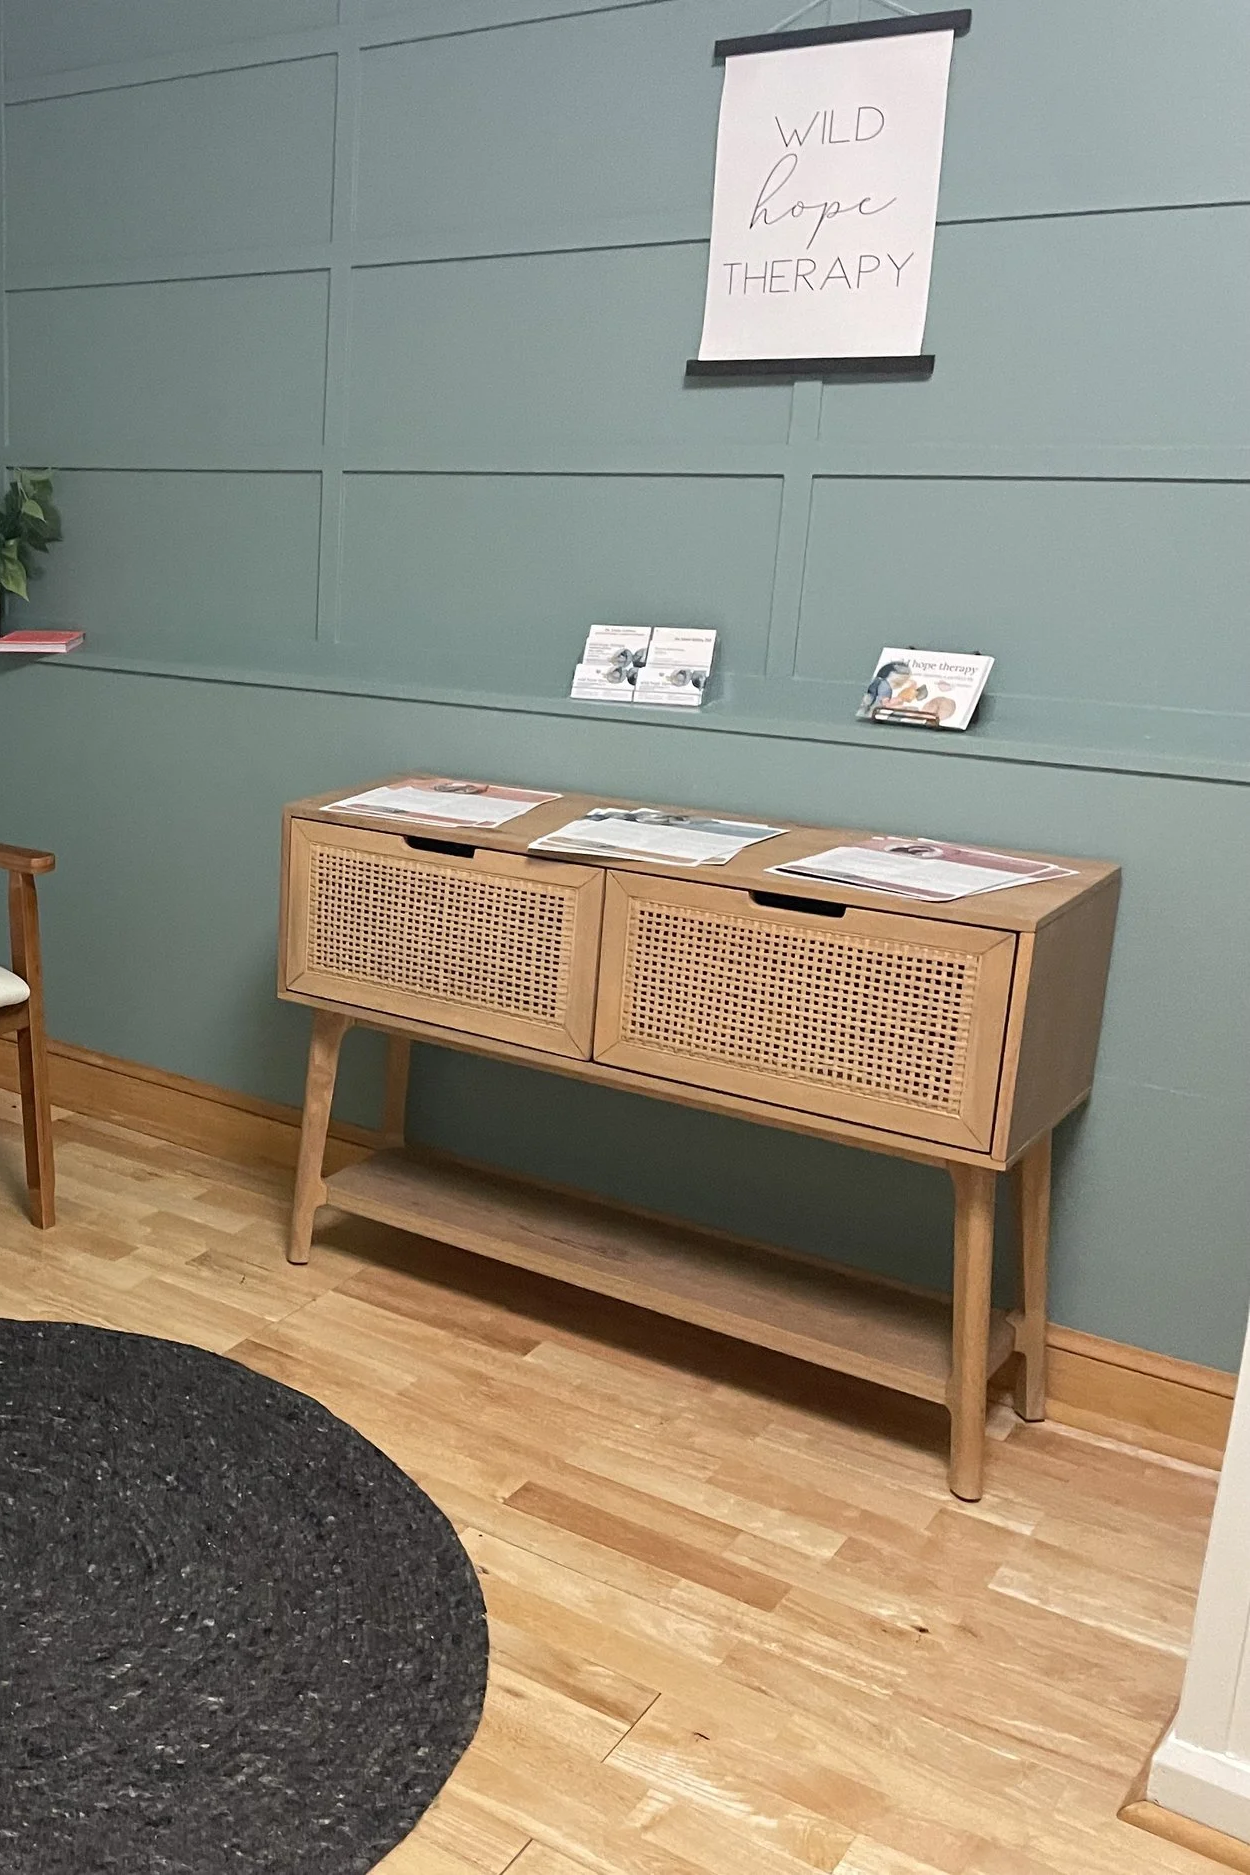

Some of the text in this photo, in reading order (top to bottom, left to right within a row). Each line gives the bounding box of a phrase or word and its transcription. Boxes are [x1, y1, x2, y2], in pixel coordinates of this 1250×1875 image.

[774, 106, 885, 148] WILD
[749, 153, 897, 250] hope
[723, 252, 915, 295] THERAPY
[911, 659, 937, 671] hope
[938, 661, 976, 676] therapy
